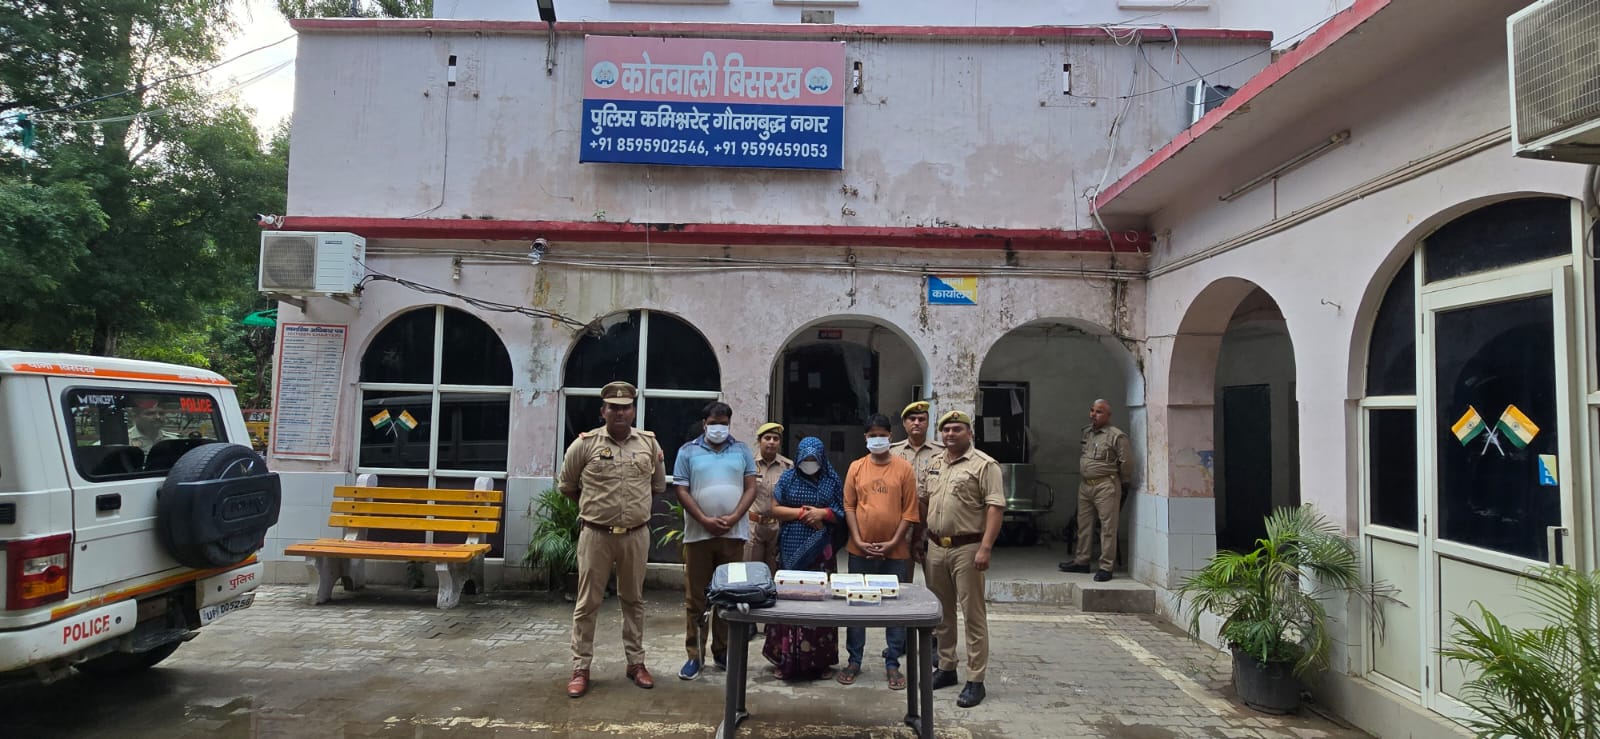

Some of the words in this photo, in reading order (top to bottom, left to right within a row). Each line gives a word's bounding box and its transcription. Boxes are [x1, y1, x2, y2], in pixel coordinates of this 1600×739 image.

[621, 51, 718, 97] कोतवाली
[723, 52, 803, 100] बिसरख
[591, 103, 637, 135] पुलिस
[713, 105, 787, 140] गौतमबुद्ध
[790, 115, 830, 133] नगर
[589, 137, 612, 151] +91
[616, 138, 709, 156] 8595902546,
[714, 141, 736, 155] +91
[741, 142, 828, 158] 9599659053
[180, 397, 213, 413] POLICE
[229, 573, 255, 591] पुलिस
[63, 615, 110, 645] POLICE
